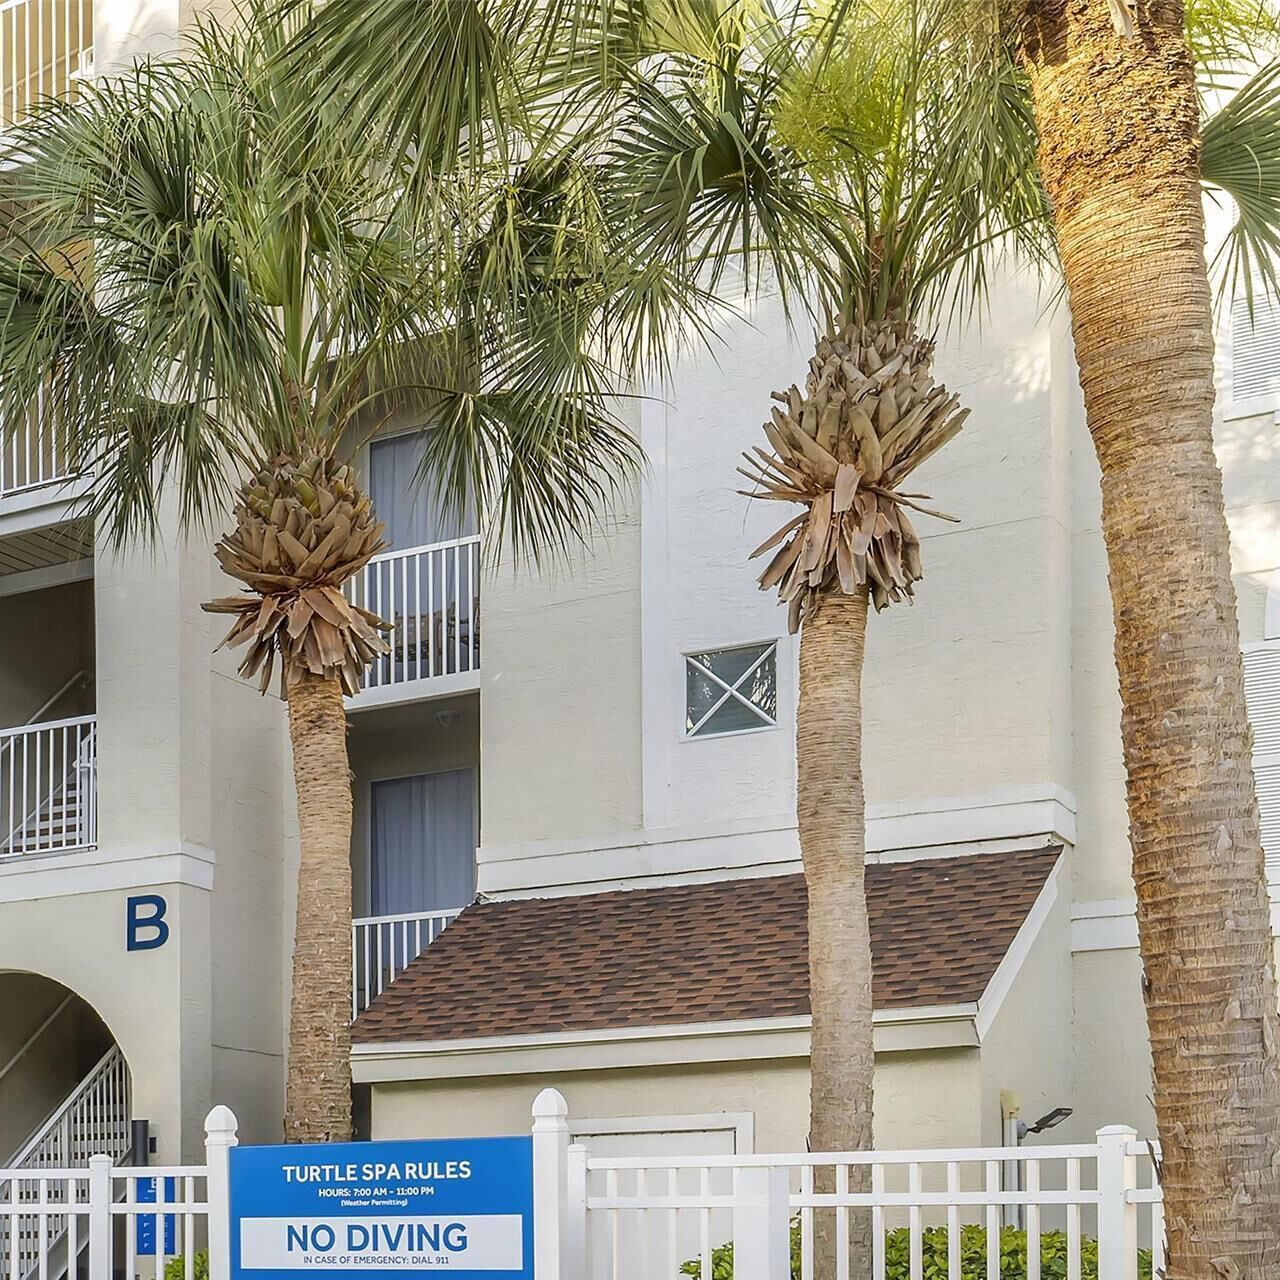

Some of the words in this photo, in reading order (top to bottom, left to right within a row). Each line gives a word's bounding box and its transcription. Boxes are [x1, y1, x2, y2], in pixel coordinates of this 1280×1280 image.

[127, 894, 170, 952] B
[283, 1164, 358, 1183] TURTLE
[362, 1163, 401, 1181] SPA
[405, 1161, 471, 1180] RULES
[318, 1188, 351, 1197] HOURS:
[353, 1188, 371, 1197] 7:00
[373, 1187, 387, 1196] AM
[397, 1187, 419, 1196] 11:00
[420, 1186, 434, 1195] PM
[341, 1199, 370, 1207] (Weather
[371, 1199, 408, 1207] Permitting)
[287, 1224, 335, 1252] NO
[347, 1223, 468, 1252] DIVING
[304, 1256, 313, 1264] IN
[314, 1256, 337, 1264] CASE
[339, 1256, 351, 1264] OF
[354, 1256, 409, 1264] EMERGENCY:
[411, 1256, 433, 1264] DIAL
[436, 1256, 449, 1264] 911
